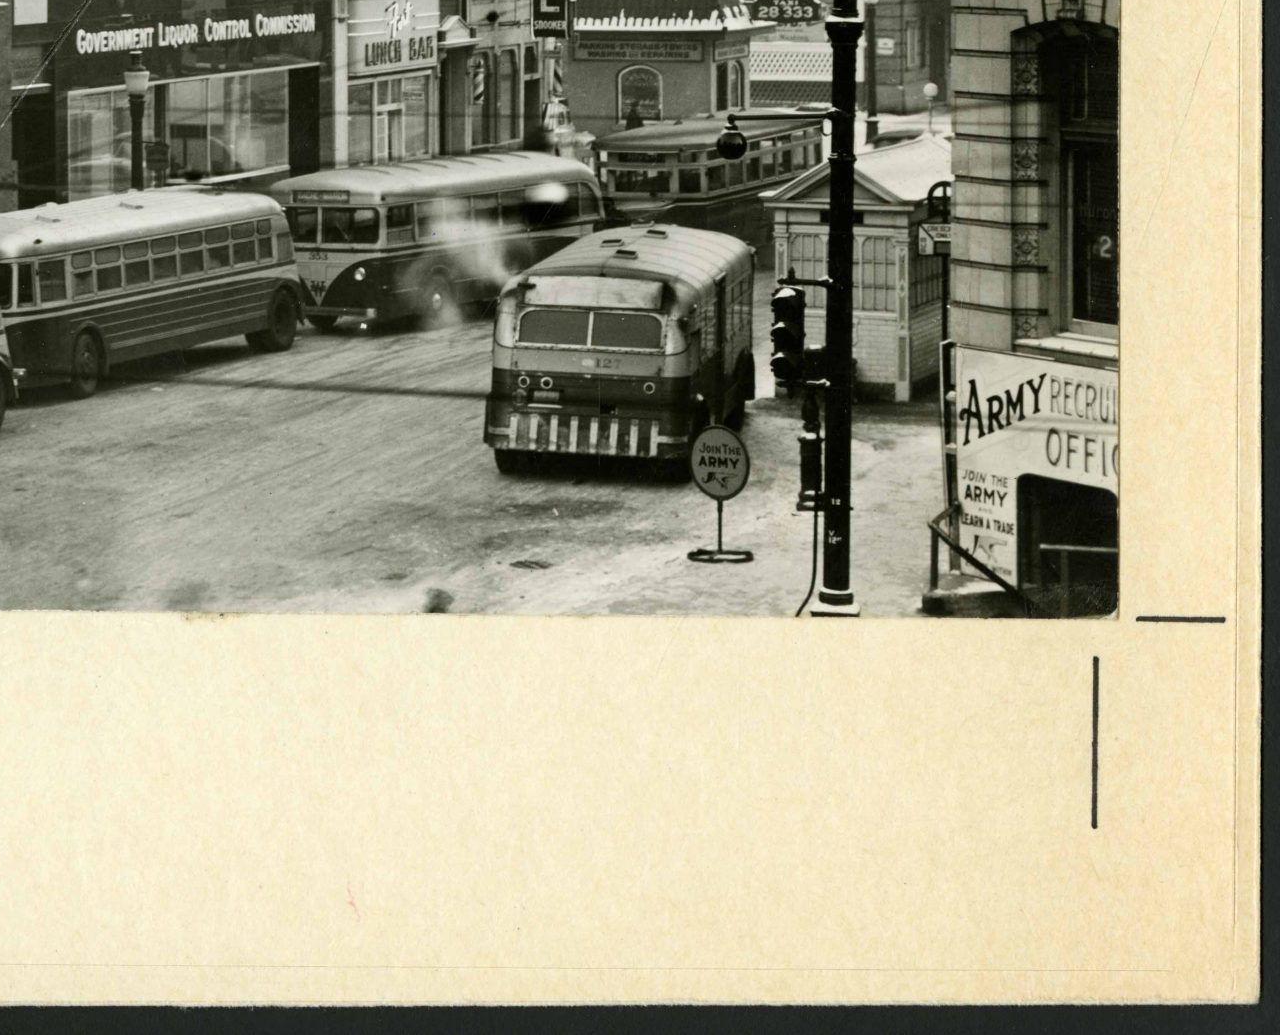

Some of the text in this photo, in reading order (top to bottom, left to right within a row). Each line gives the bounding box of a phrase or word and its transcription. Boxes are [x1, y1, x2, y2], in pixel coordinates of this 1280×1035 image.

[365, 35, 434, 67] LUNCH BAR
[959, 373, 1047, 446] ARMY
[698, 442, 742, 455] JOIN THE
[698, 456, 739, 469] ARMY
[962, 469, 1008, 488] JOIN THE
[964, 483, 1008, 508] ARMY
[961, 512, 1014, 535] LEARN A TRADE
